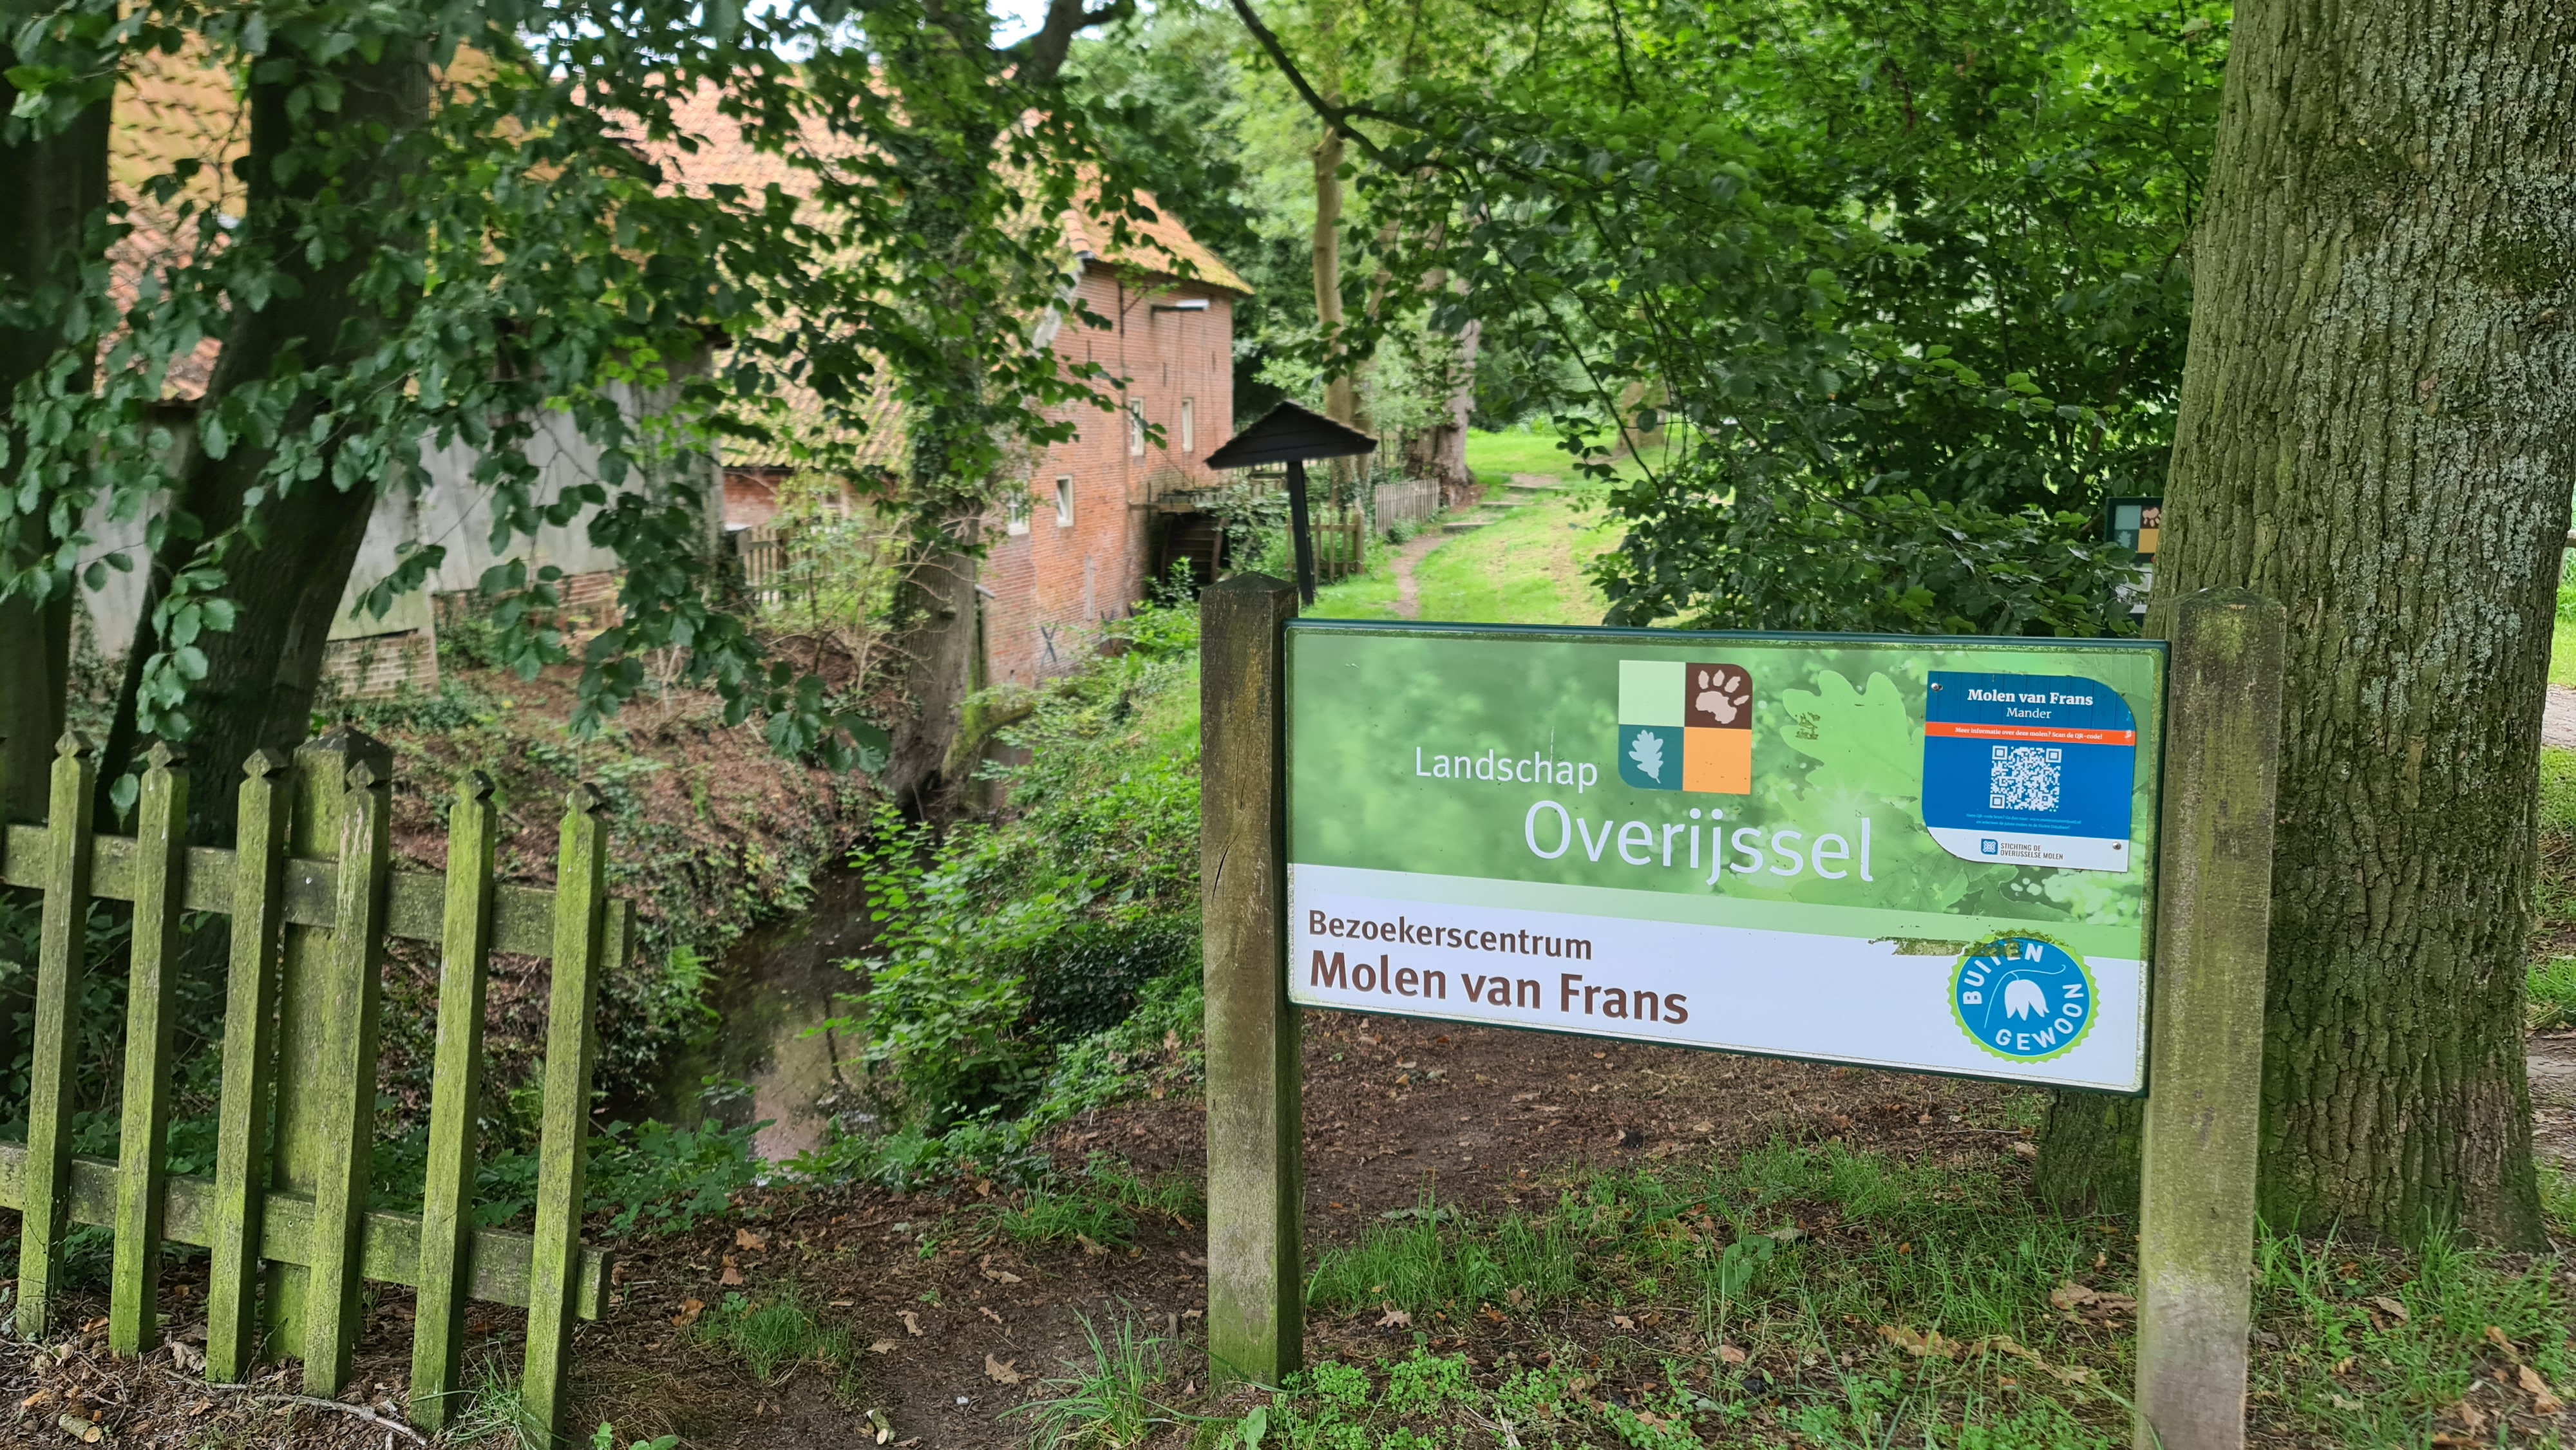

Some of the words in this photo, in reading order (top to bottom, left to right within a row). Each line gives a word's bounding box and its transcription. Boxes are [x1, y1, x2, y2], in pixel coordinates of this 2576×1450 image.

[1967, 689, 2015, 702] Molen
[2018, 693, 2046, 704] van
[2049, 692, 2094, 706] Frans
[2006, 708, 2052, 719] Mander
[1416, 747, 1598, 793] Landschap
[1525, 800, 1873, 885] Overijssel
[2000, 843, 2032, 851] STICHTING
[2000, 850, 2041, 858] OVERIJSSELSE
[1309, 910, 1592, 960] Bezoekerscentrum
[1311, 950, 1446, 999] Molen
[1461, 973, 1541, 1009] van
[1561, 973, 1689, 1024] Frans
[1963, 942, 2043, 1004] BUITEN
[1995, 983, 2084, 1051] GEWOON
